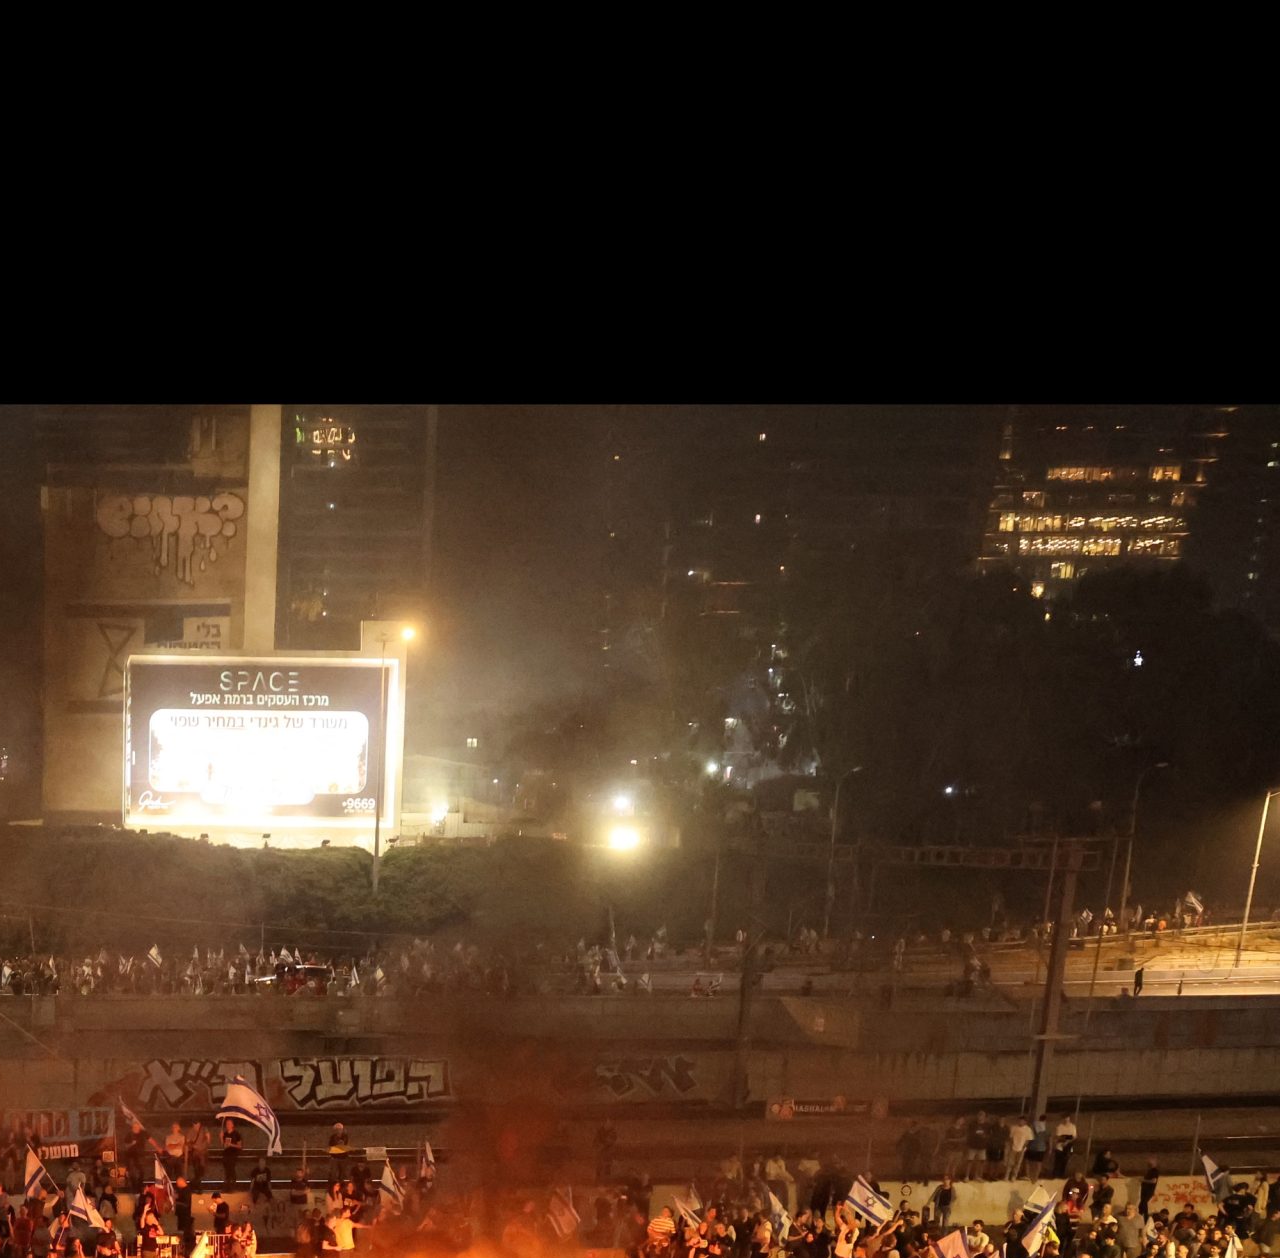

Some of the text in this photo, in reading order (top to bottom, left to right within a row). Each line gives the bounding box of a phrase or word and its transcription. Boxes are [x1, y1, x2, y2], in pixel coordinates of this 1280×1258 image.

[219, 670, 300, 692] SPACE
[190, 691, 330, 708] מרכז העסקים ברמת אפעל
[170, 714, 200, 728] שפוי
[207, 715, 245, 728] במחיר
[249, 715, 279, 728] גינדי
[283, 714, 304, 728] של
[279, 1057, 452, 1108] הפועל
